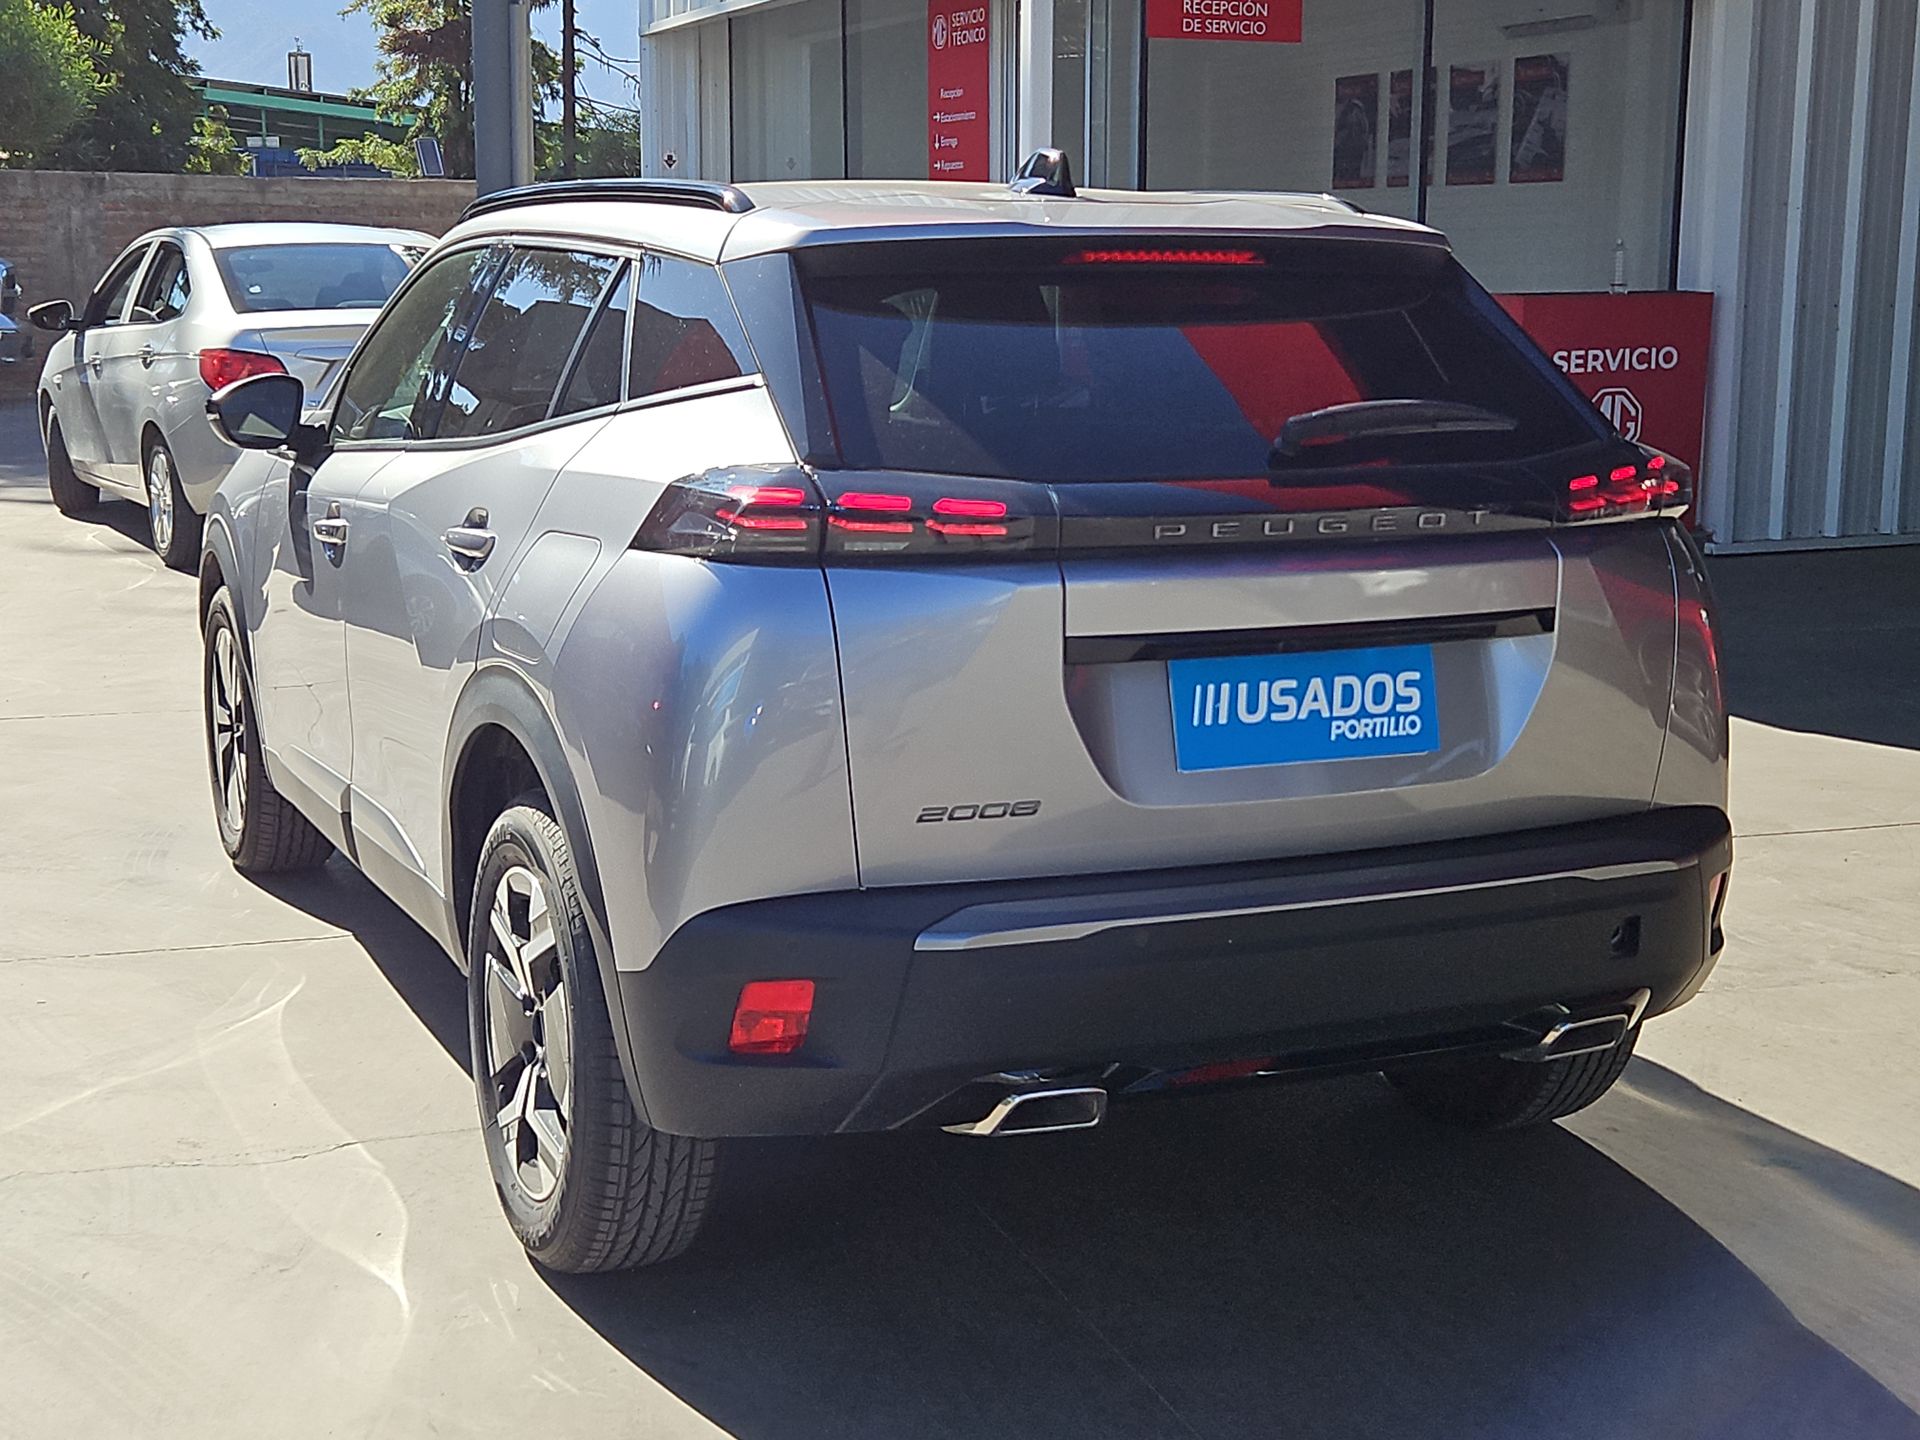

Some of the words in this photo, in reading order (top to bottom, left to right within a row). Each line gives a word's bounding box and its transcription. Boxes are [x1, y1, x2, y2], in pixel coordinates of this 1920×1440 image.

[952, 7, 985, 28] SERVICIO
[1183, 0, 1268, 17] RECEPCIÓN
[952, 27, 986, 47] TÉCNICO
[1182, 18, 1202, 32] DE
[1205, 19, 1266, 35] SERVICIO
[1552, 345, 1678, 374] SERVICIO
[1153, 509, 1491, 540] PEUGEOT
[1236, 671, 1422, 724] USADOS
[1330, 714, 1422, 741] PORTILLO
[915, 800, 1042, 823] 2008
